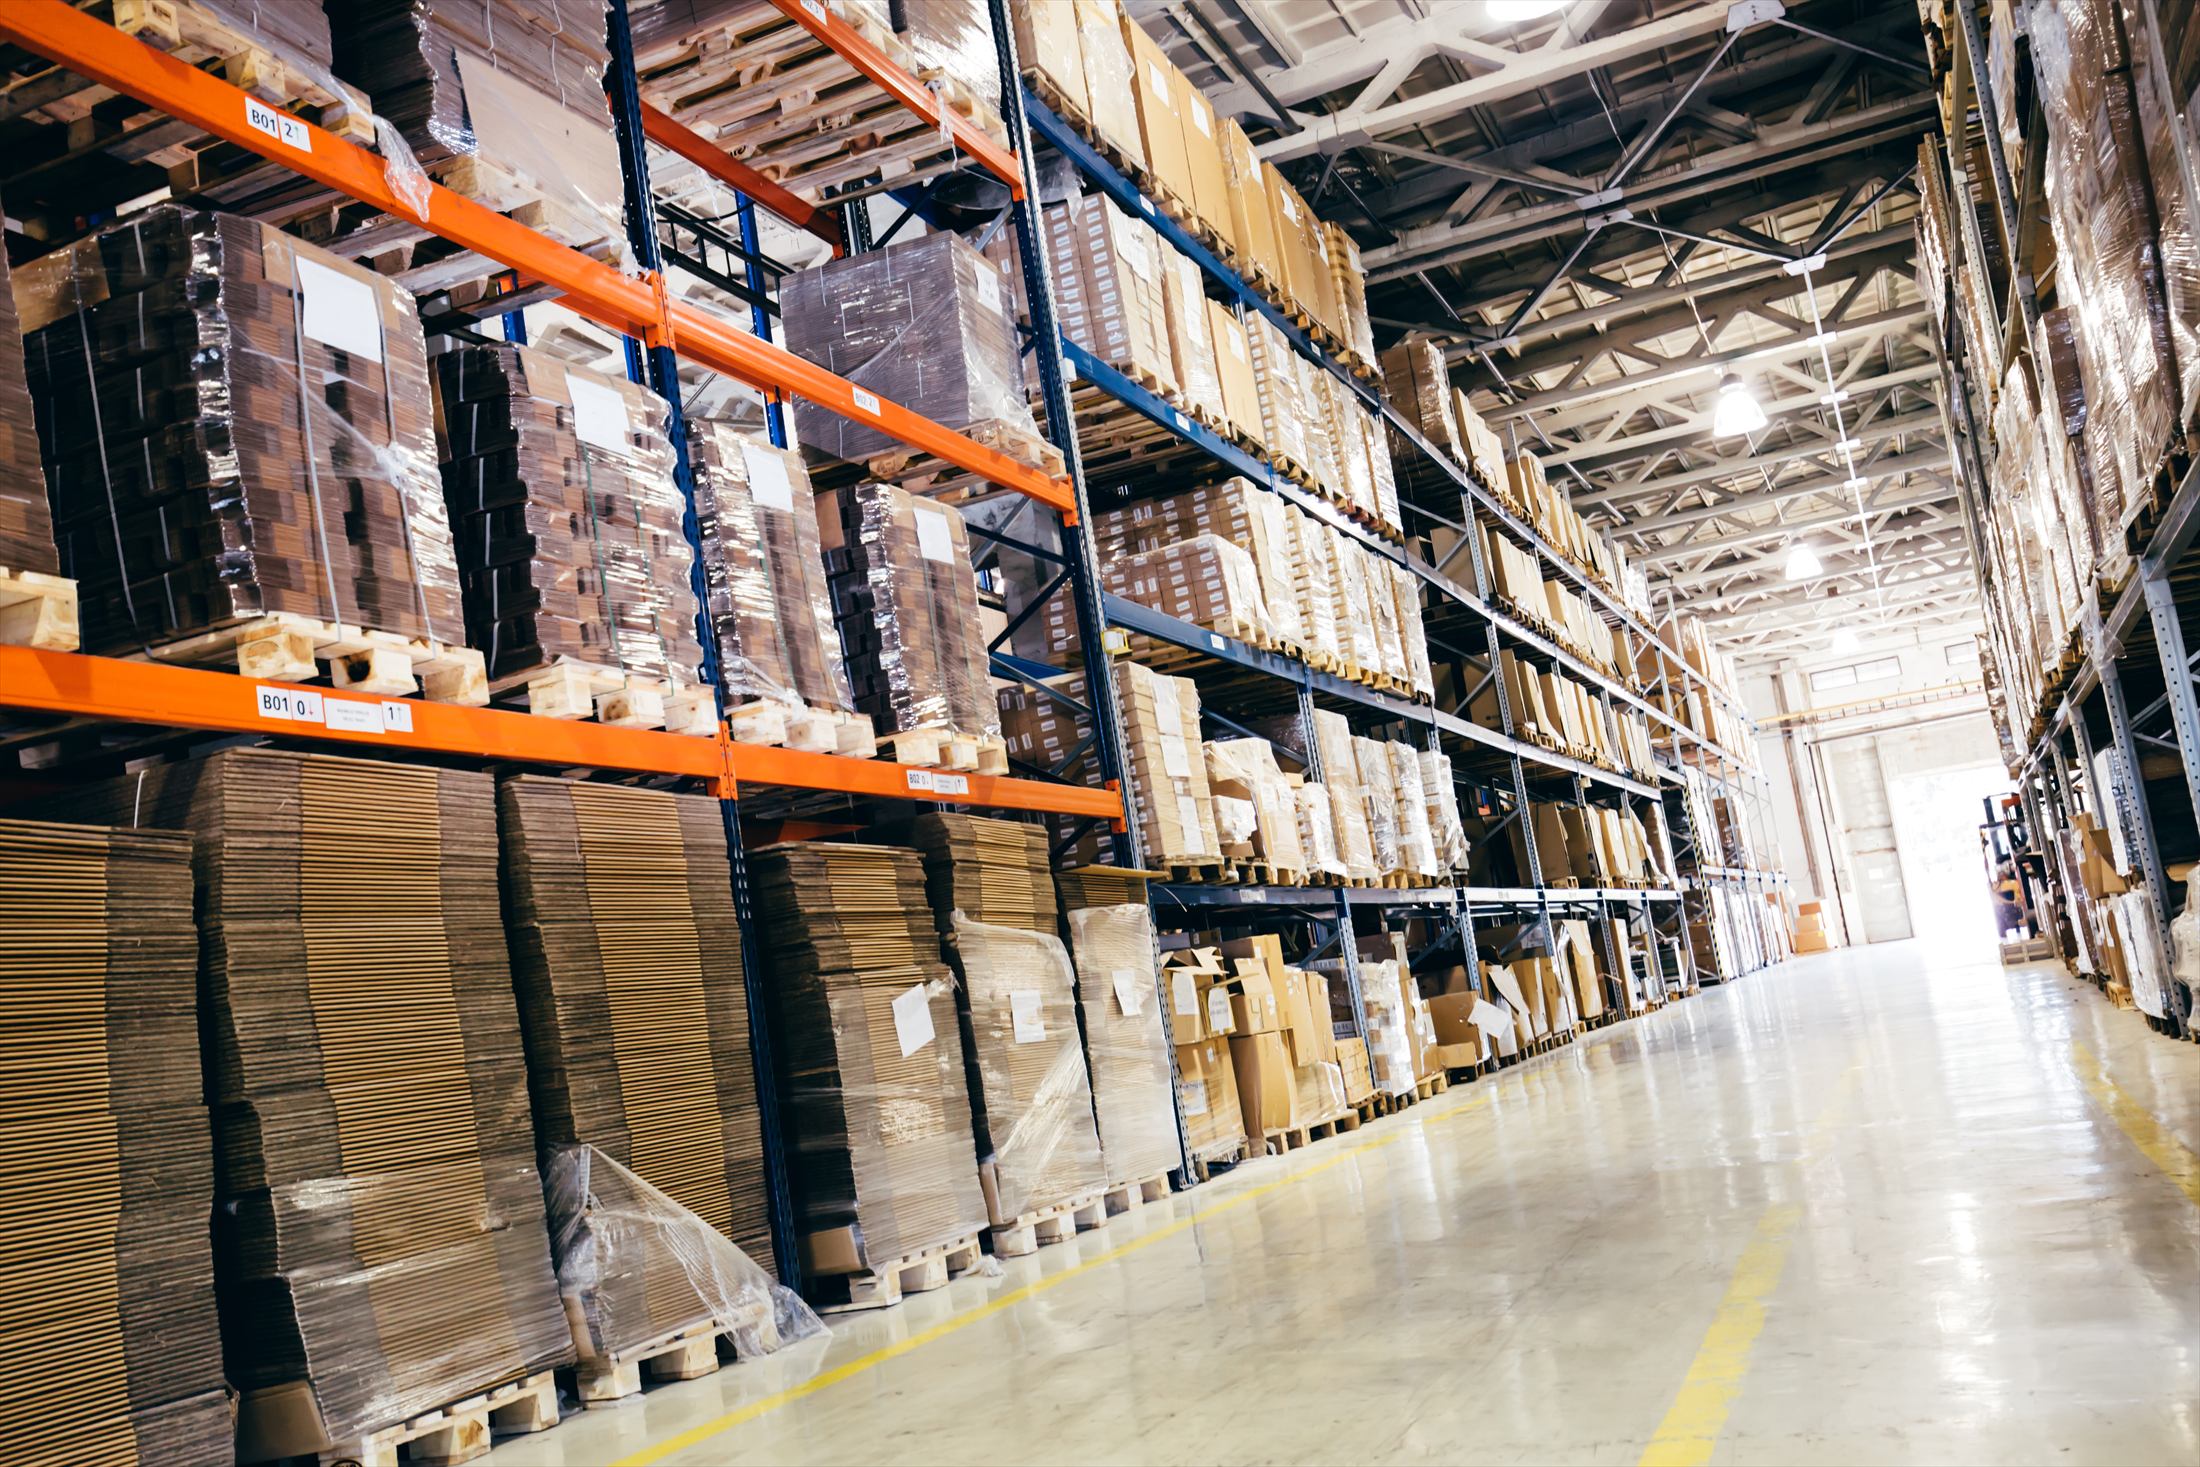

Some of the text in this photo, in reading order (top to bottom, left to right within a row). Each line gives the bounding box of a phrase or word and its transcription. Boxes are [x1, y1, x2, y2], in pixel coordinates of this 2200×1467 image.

[252, 109, 293, 138] B01 2
[263, 694, 394, 721] B01 0 1
